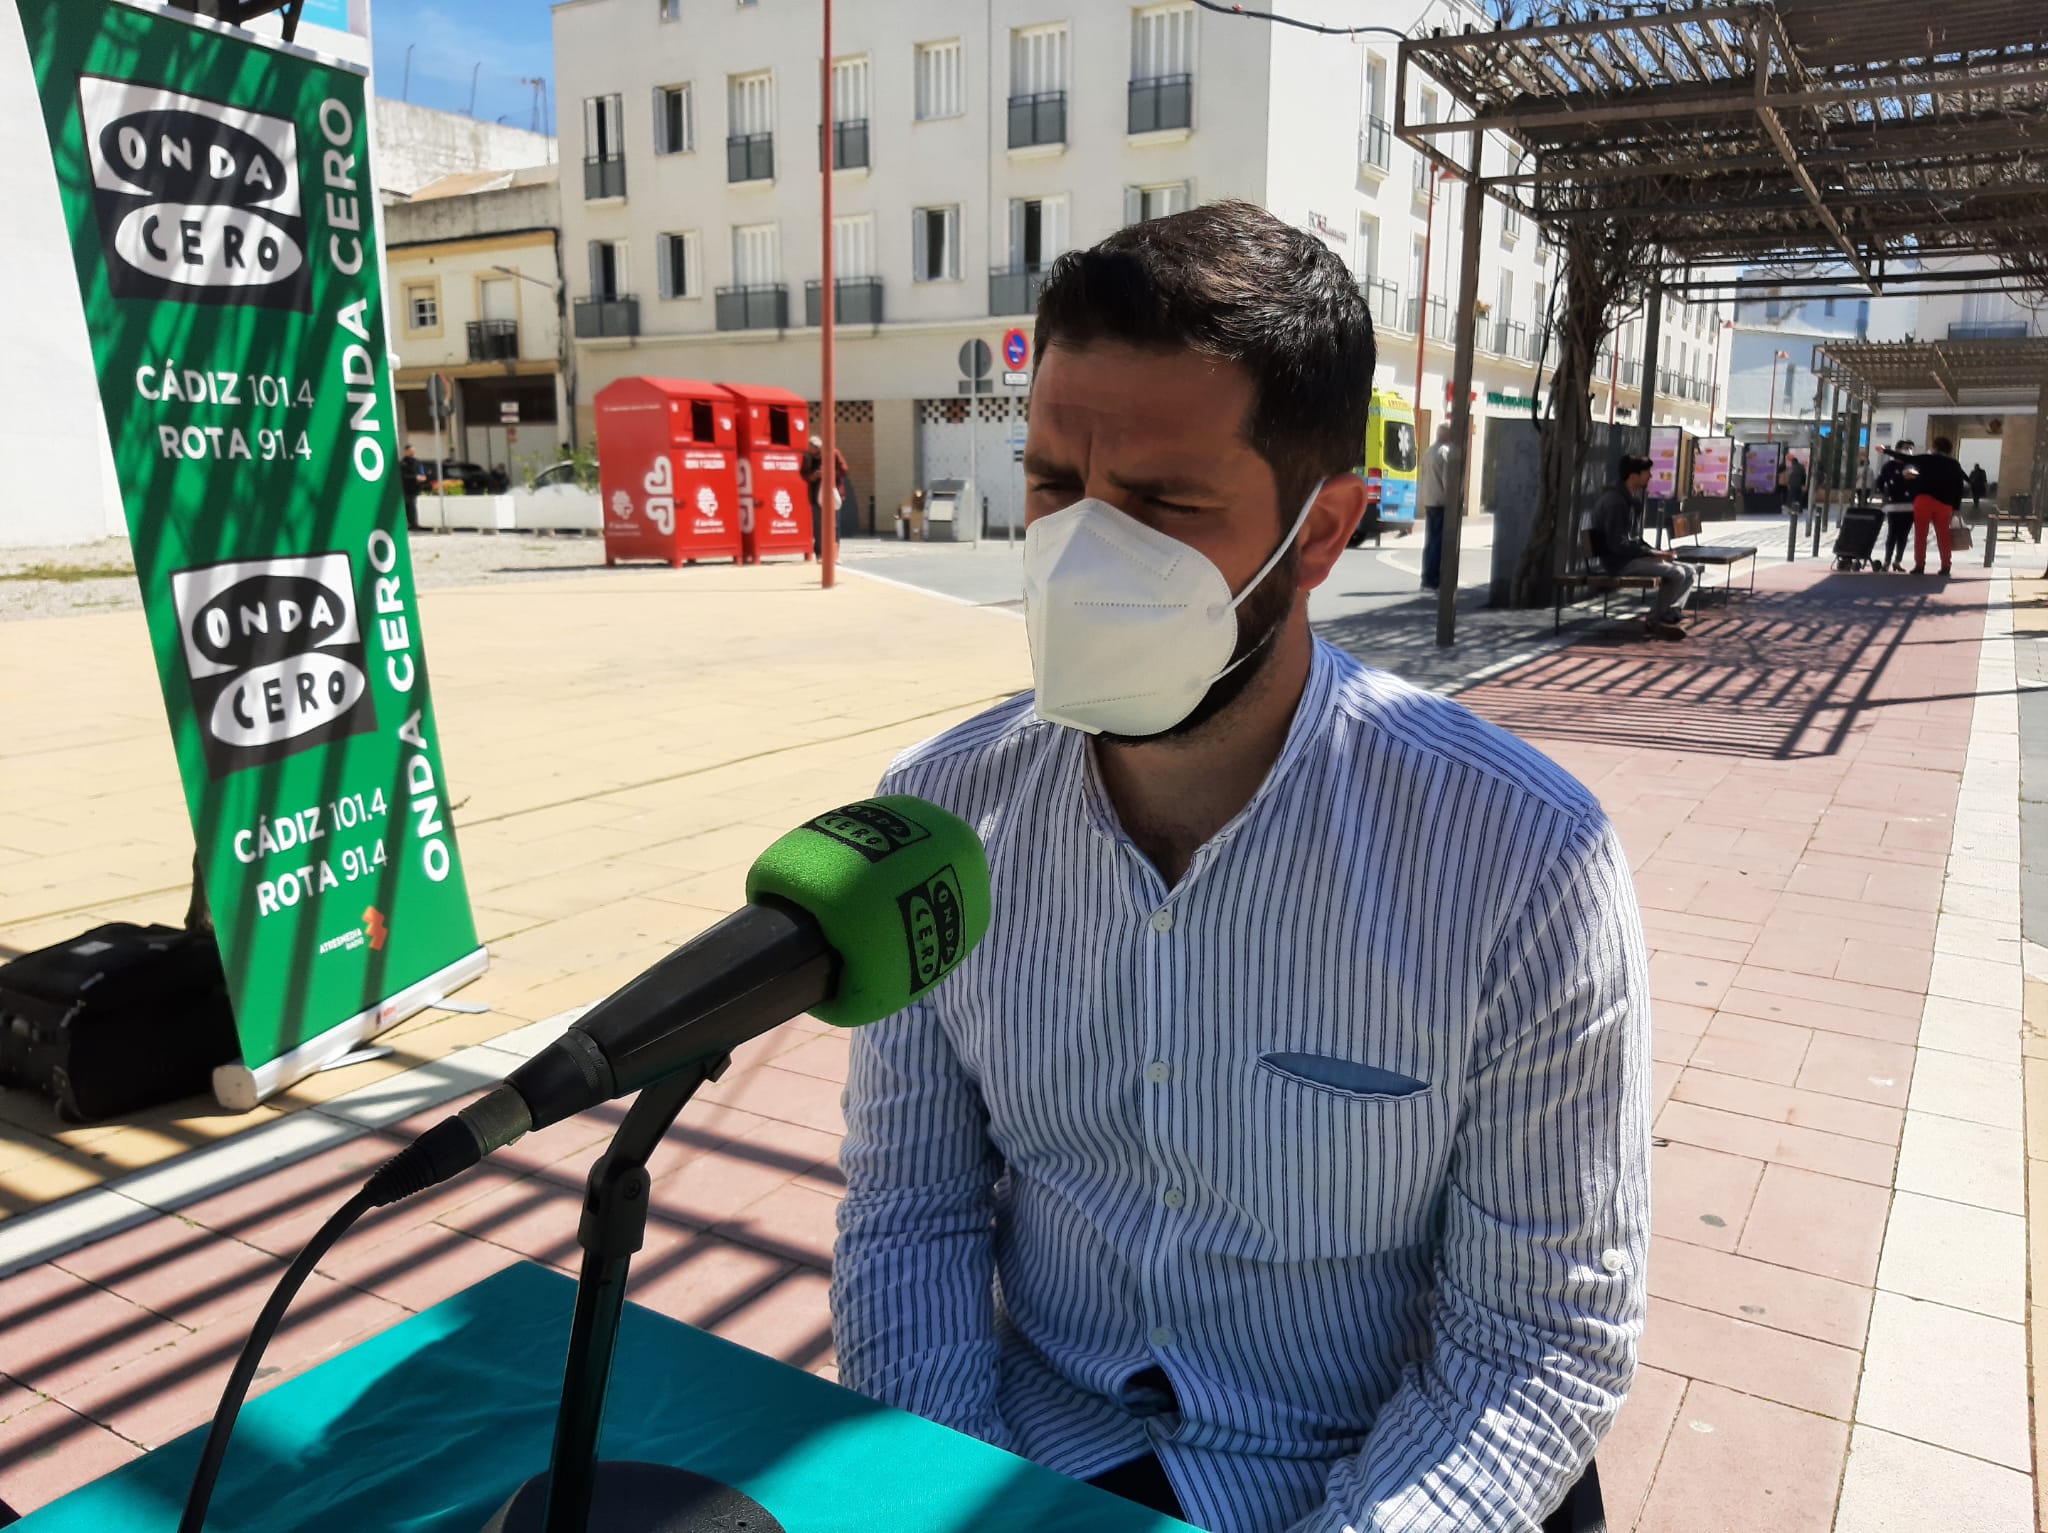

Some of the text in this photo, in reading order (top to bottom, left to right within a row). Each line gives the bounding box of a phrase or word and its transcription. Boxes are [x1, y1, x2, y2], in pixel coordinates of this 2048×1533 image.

[119, 126, 272, 190] ONDA
[142, 216, 280, 272] CERO
[319, 97, 385, 482] ONDA CERO
[136, 359, 315, 409] CÁDIZ 101.4
[158, 425, 313, 461] ROTA 91.4
[206, 595, 334, 648] ONDA
[234, 671, 346, 729] CERO
[368, 529, 450, 882] ONDA CERO
[234, 787, 388, 864] CÁDIZ 101.4
[825, 816, 881, 845] CERO
[257, 839, 388, 916] ROTA 91.4
[916, 908, 935, 974] CERO
[938, 887, 955, 956] ONDA
